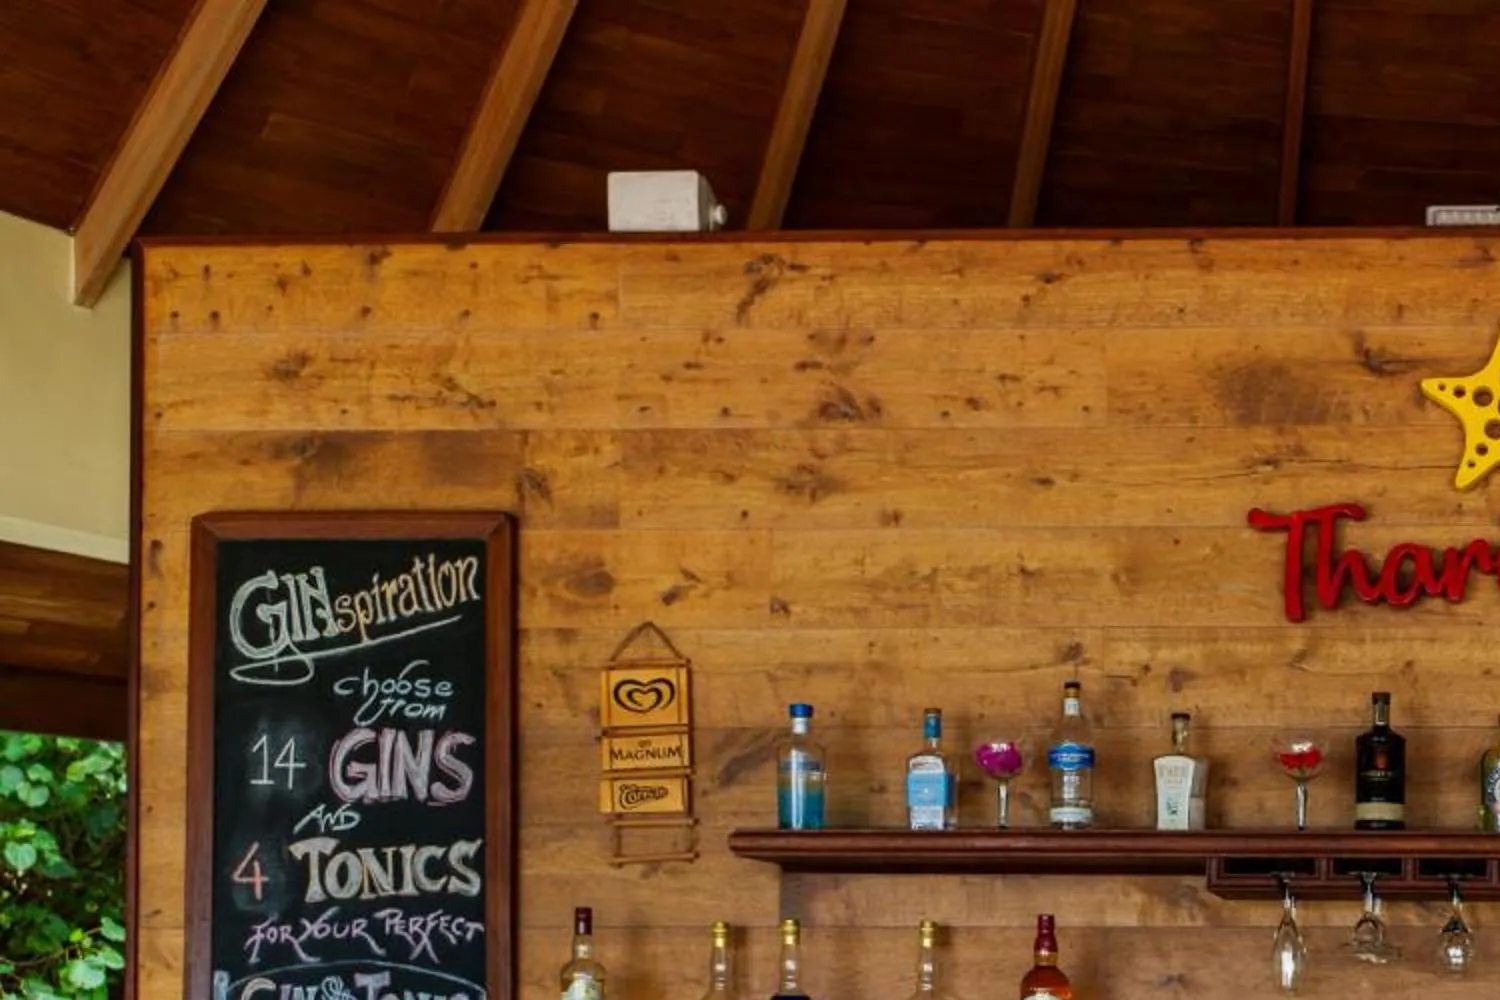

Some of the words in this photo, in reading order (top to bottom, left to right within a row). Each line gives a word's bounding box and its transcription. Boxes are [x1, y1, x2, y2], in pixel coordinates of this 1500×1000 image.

[333, 660, 453, 727] choose
[376, 696, 447, 721] from
[249, 733, 307, 790] 14
[328, 727, 477, 806] GINS
[610, 746, 682, 761] MAGNUM
[292, 803, 361, 834] AND
[231, 841, 270, 901] 4
[288, 836, 483, 903] TONICS
[374, 908, 485, 964] PERFECT
